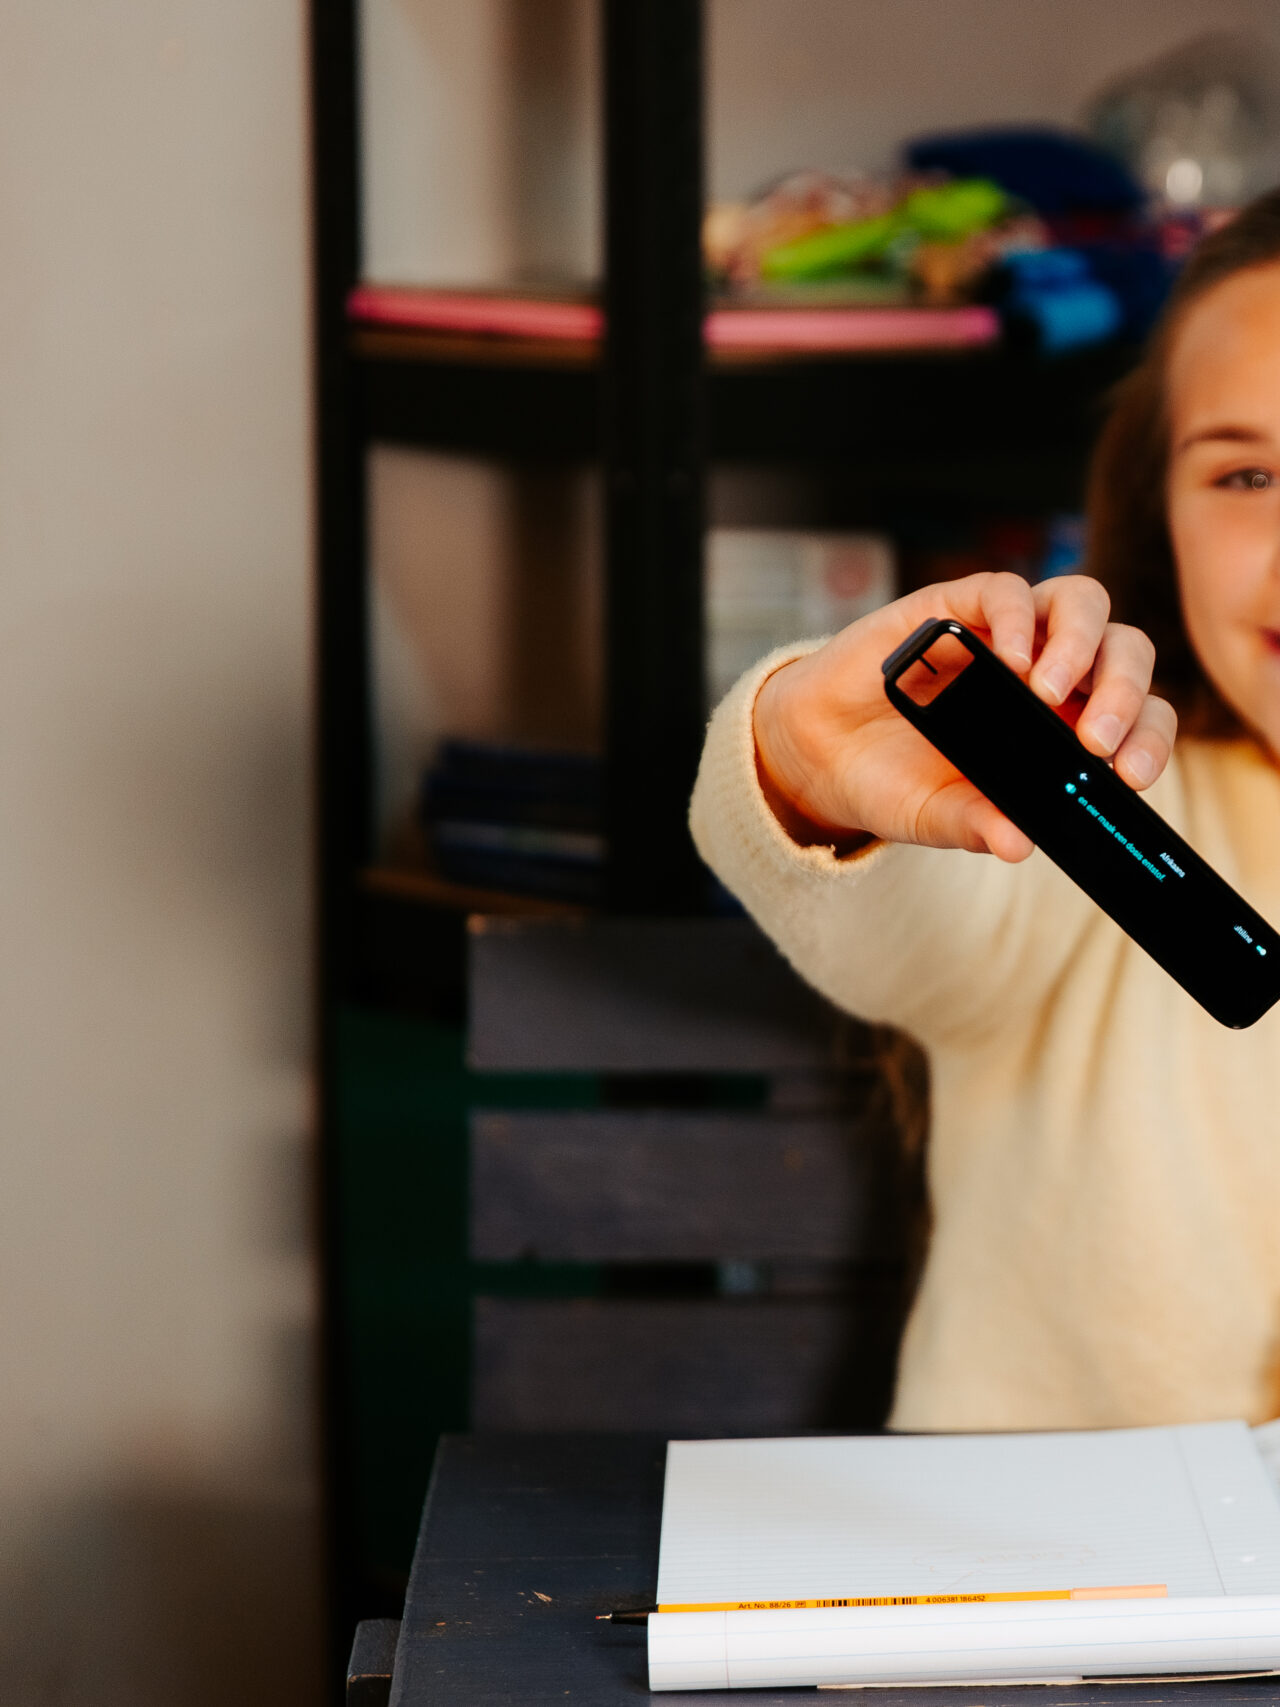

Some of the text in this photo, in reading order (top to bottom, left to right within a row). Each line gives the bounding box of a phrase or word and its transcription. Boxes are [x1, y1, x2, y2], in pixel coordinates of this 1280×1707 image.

[1098, 815, 1117, 834] maak
[1114, 831, 1128, 846] een
[1126, 842, 1144, 861] dosis
[1159, 852, 1186, 878] Afrikaans
